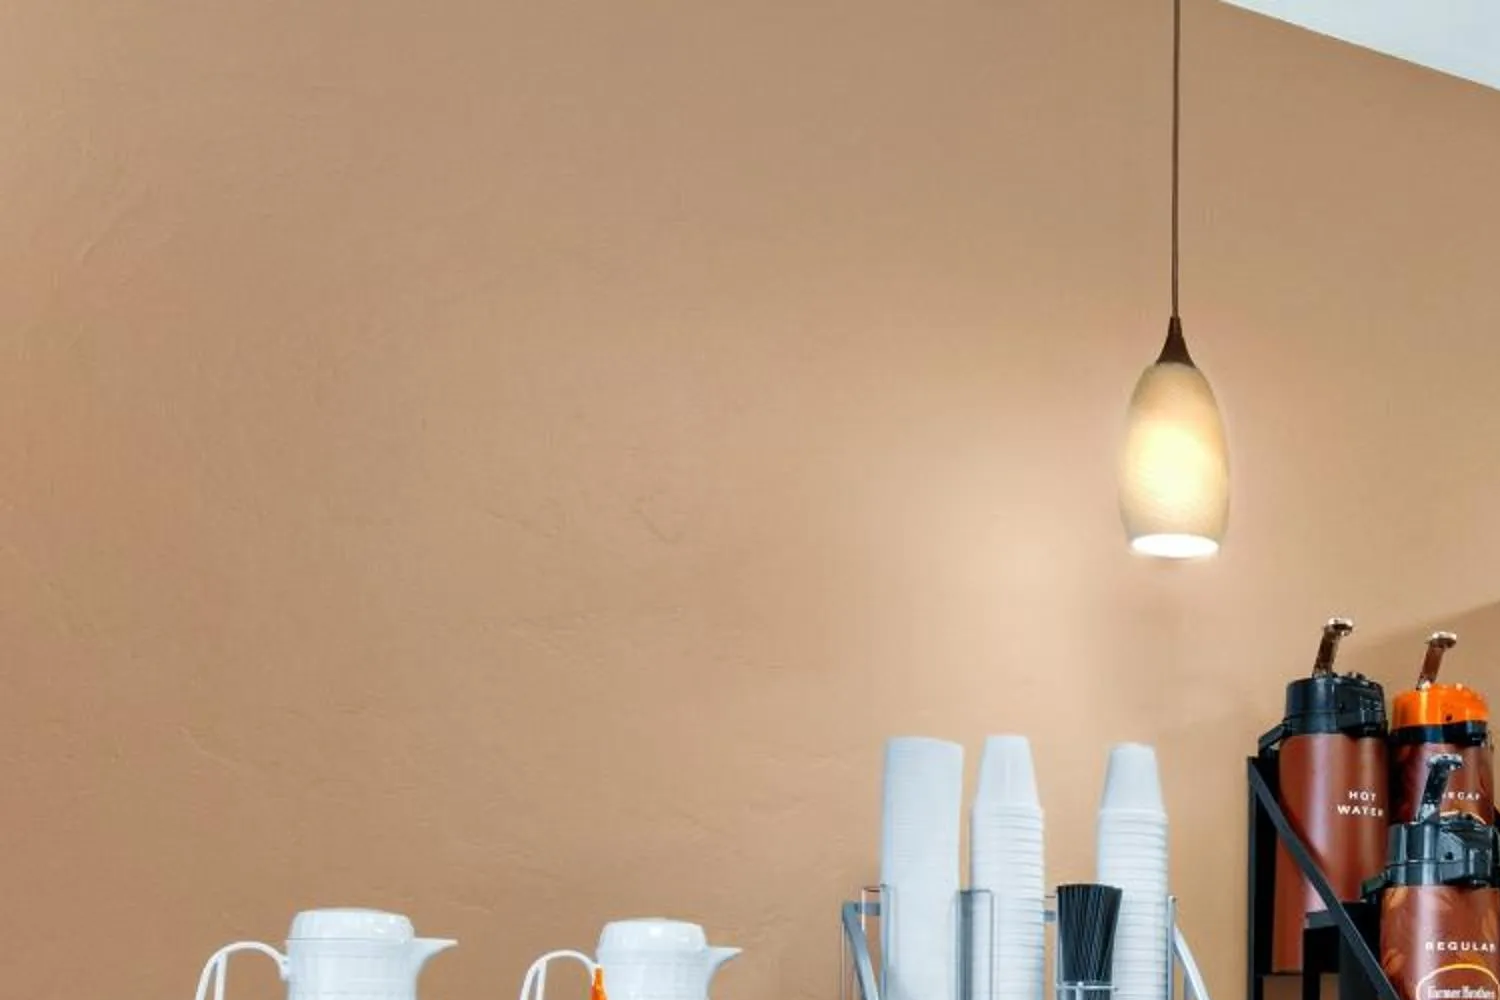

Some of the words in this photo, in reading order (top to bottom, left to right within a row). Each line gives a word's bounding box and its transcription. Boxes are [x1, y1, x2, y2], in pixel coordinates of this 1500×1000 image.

[1348, 790, 1377, 802] HOT
[1336, 804, 1384, 817] WATER
[1425, 941, 1496, 953] REGULAR
